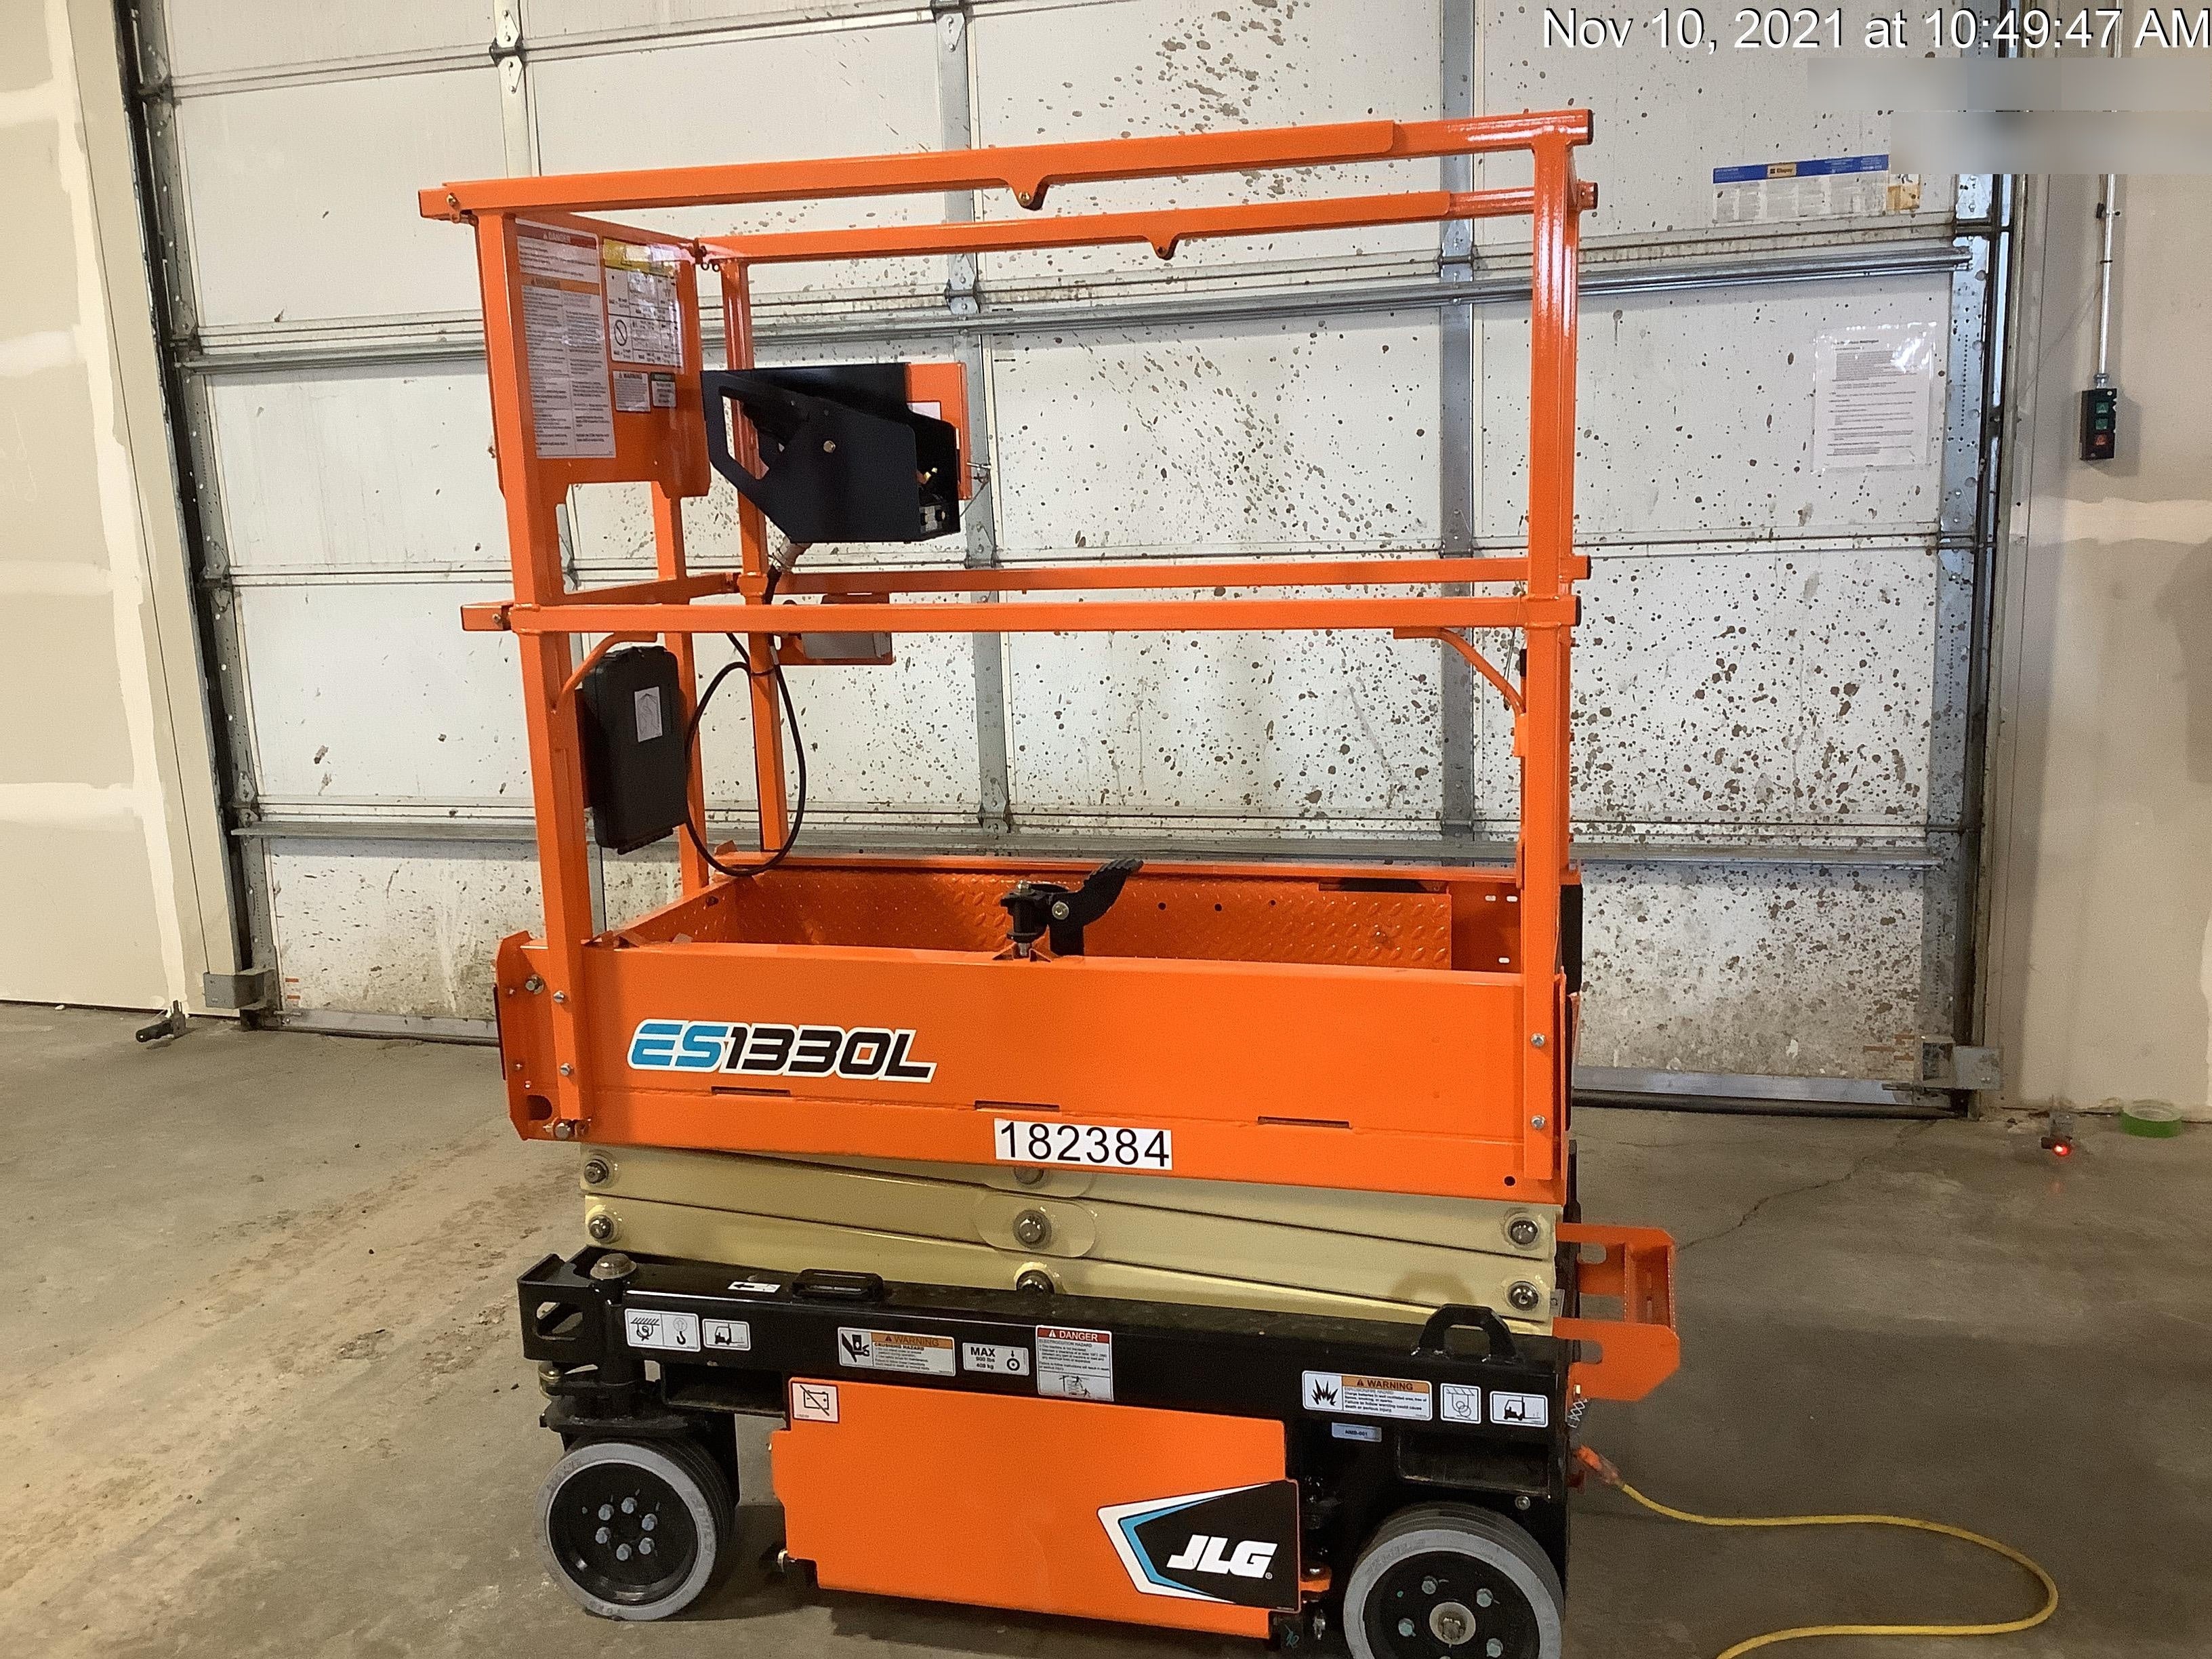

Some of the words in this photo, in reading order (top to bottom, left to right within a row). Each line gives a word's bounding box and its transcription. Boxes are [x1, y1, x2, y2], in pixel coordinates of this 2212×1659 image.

[630, 1021, 936, 1080] ES1330L
[999, 1121, 1170, 1168] 182384
[894, 1335, 940, 1347] WARNING
[1059, 1330, 1098, 1342] DANGER
[970, 1347, 996, 1357] MAX
[1367, 1379, 1414, 1391] WARNING
[1166, 1534, 1278, 1579] JLG
